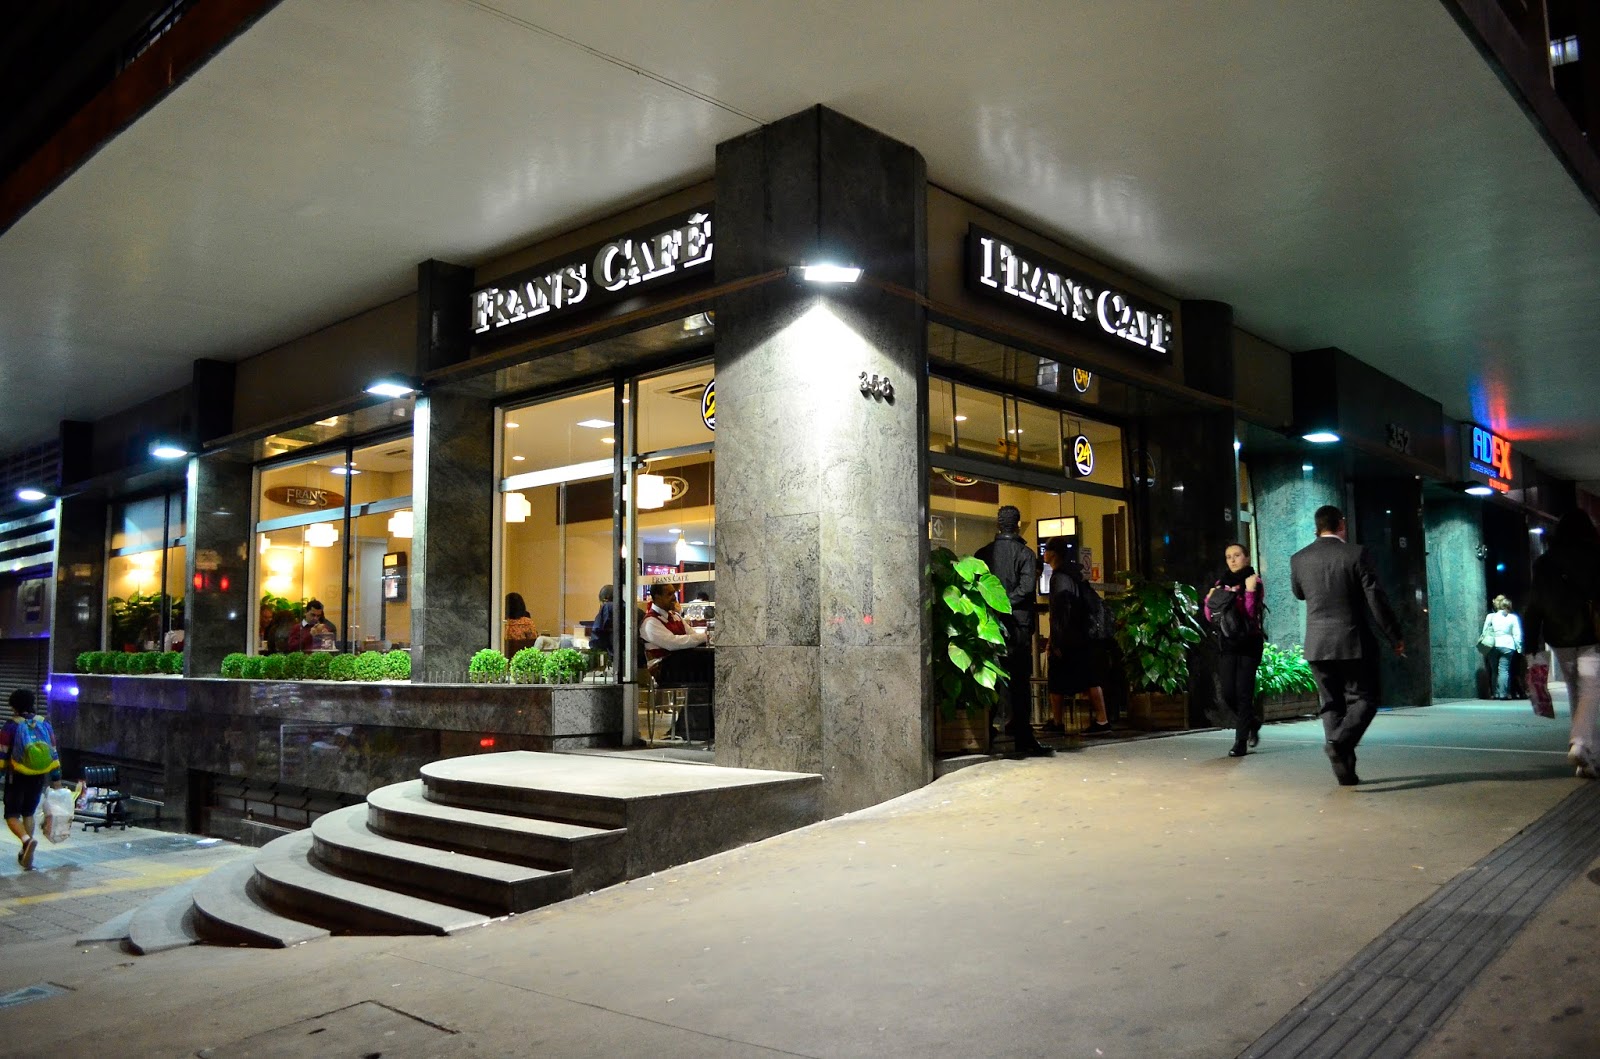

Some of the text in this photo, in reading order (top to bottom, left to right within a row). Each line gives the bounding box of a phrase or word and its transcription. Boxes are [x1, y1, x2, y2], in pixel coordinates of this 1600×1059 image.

[593, 212, 713, 291] CAFÉ
[1076, 442, 1091, 467] 24
[1473, 427, 1512, 480] ADEX
[286, 488, 328, 507] FRAN'S
